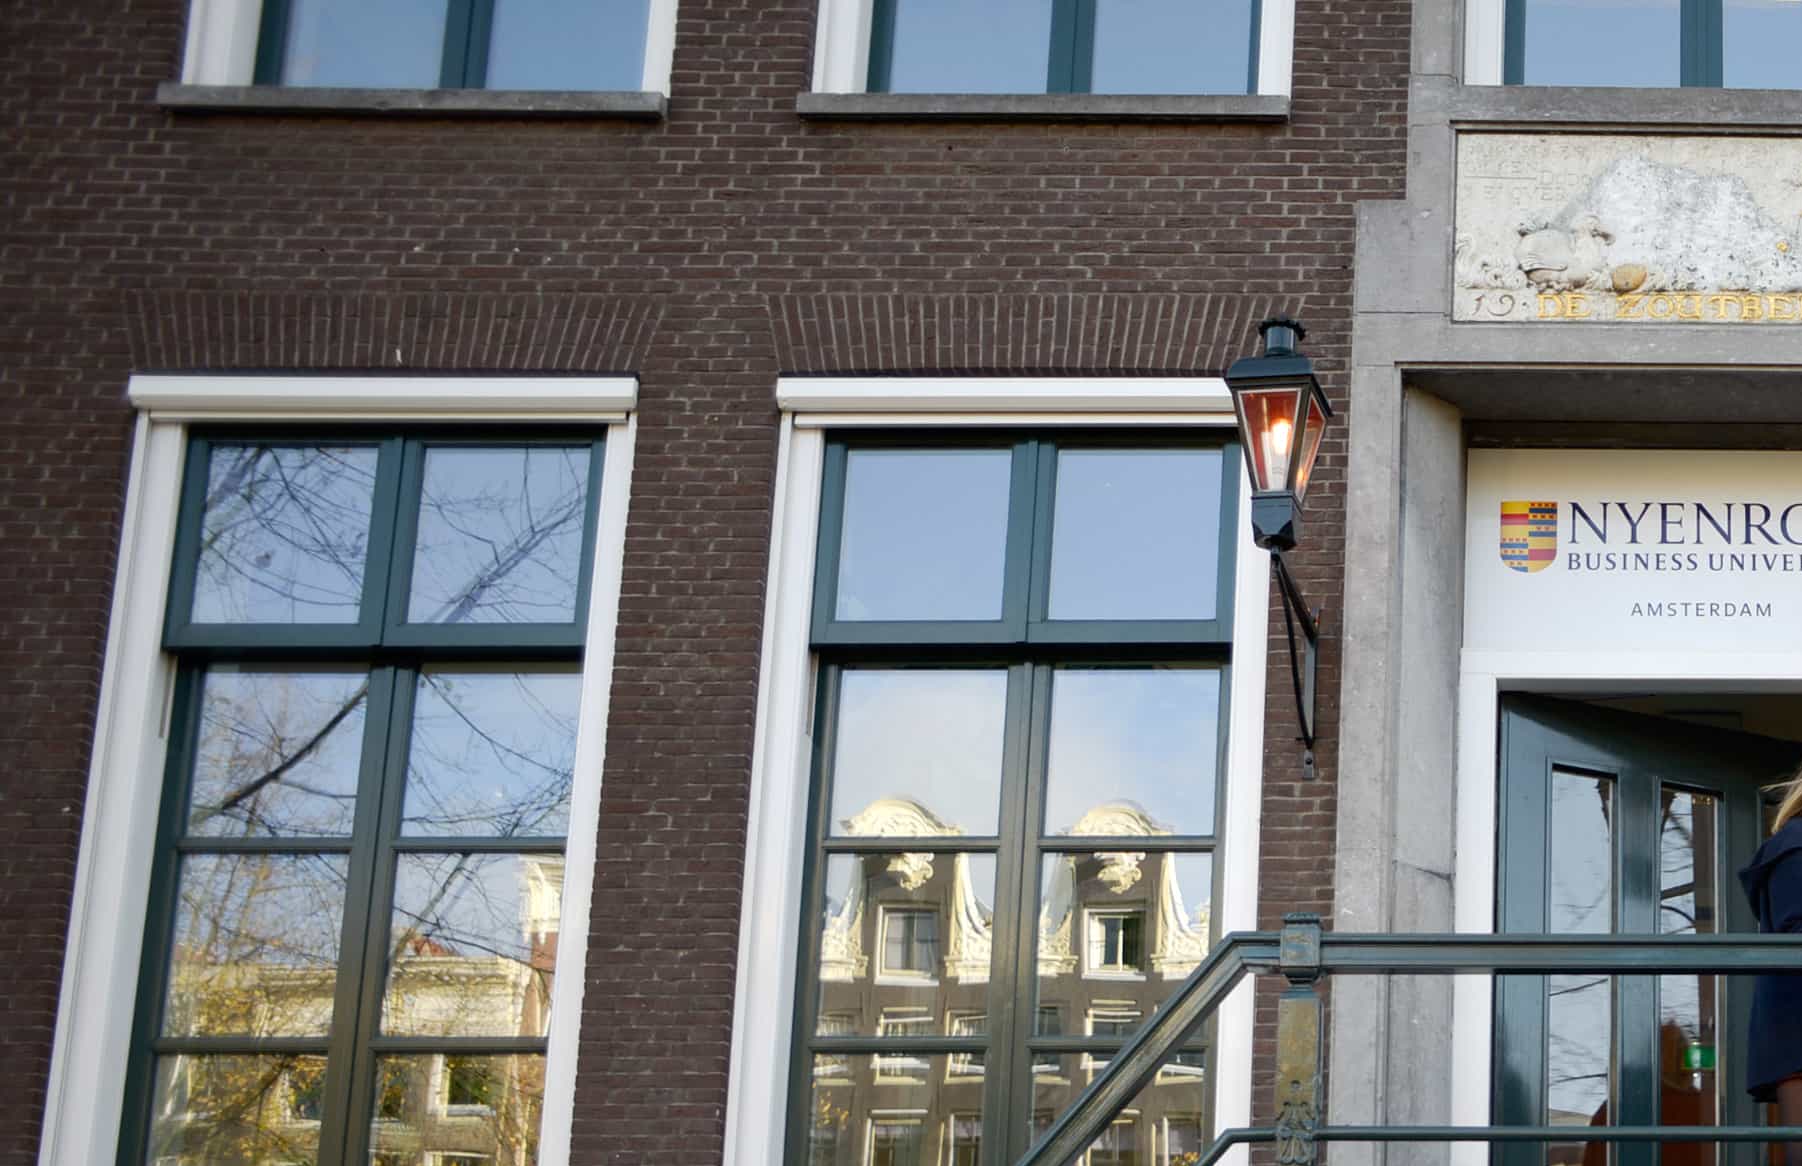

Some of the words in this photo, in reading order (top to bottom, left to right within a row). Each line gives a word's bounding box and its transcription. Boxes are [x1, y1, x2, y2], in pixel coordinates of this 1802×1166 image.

[1536, 292, 1591, 319] DE
[1567, 552, 1698, 572] BUSINESS
[1631, 602, 1773, 617] AMSTERDAM
